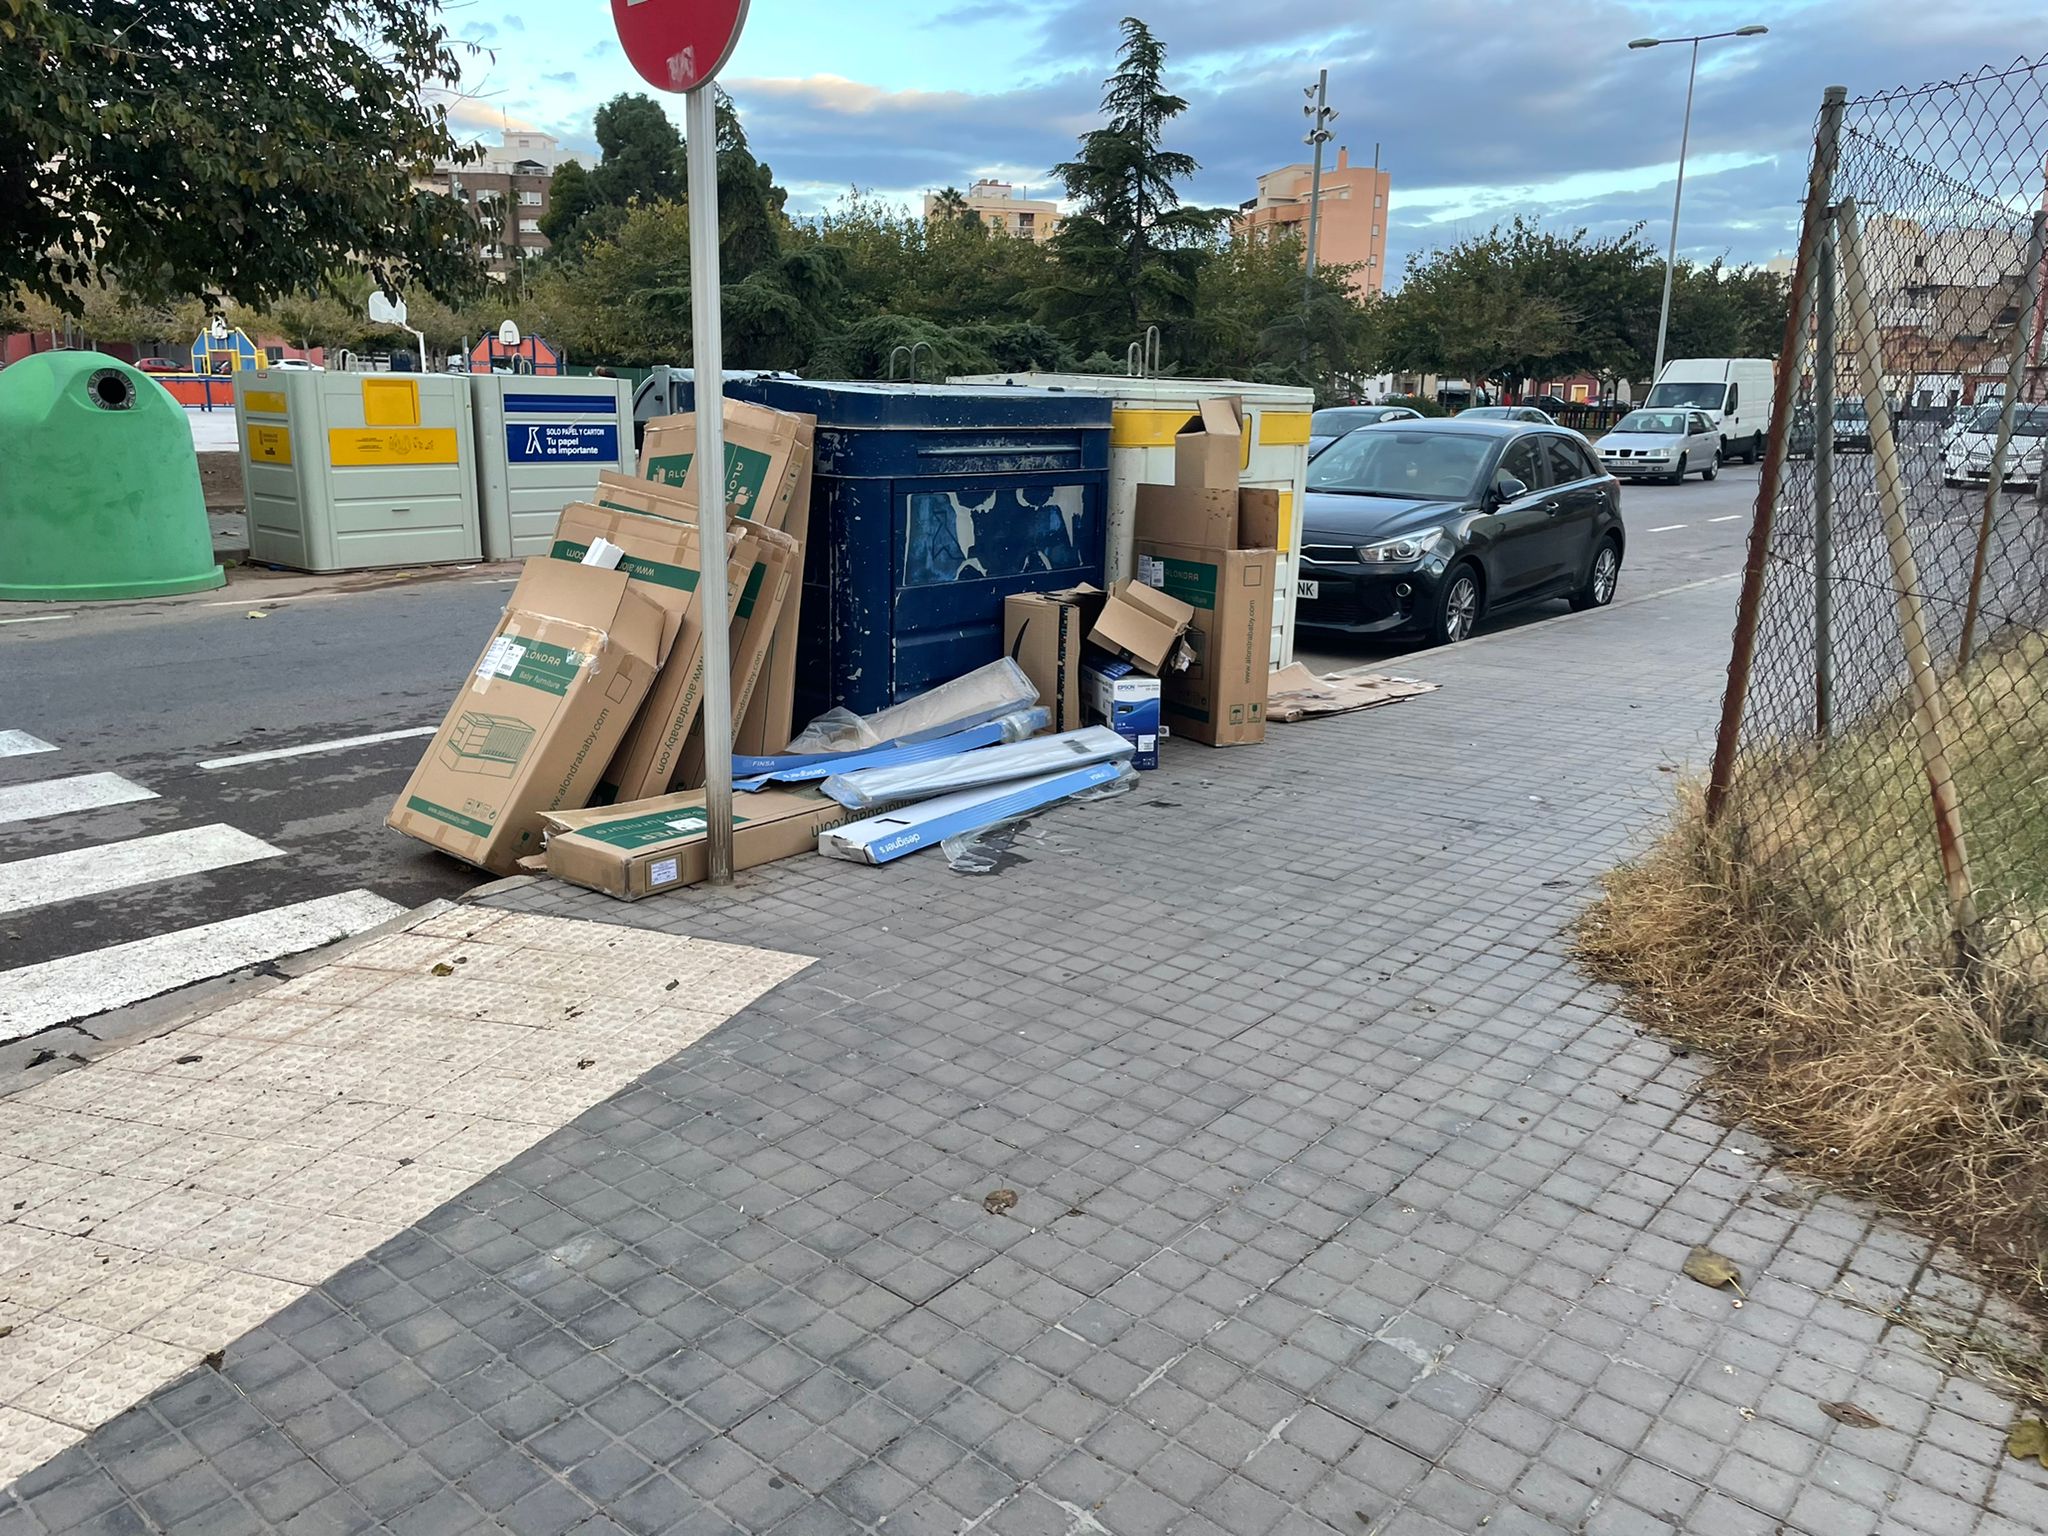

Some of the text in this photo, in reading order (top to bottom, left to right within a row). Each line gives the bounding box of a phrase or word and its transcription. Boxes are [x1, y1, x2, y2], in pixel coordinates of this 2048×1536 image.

[546, 428, 561, 436] SOLO
[562, 428, 579, 436] PAPEL
[546, 437, 579, 447] Tu papel
[547, 446, 599, 456] es importante
[1297, 582, 1313, 596] NK
[523, 650, 562, 667] LONDRA
